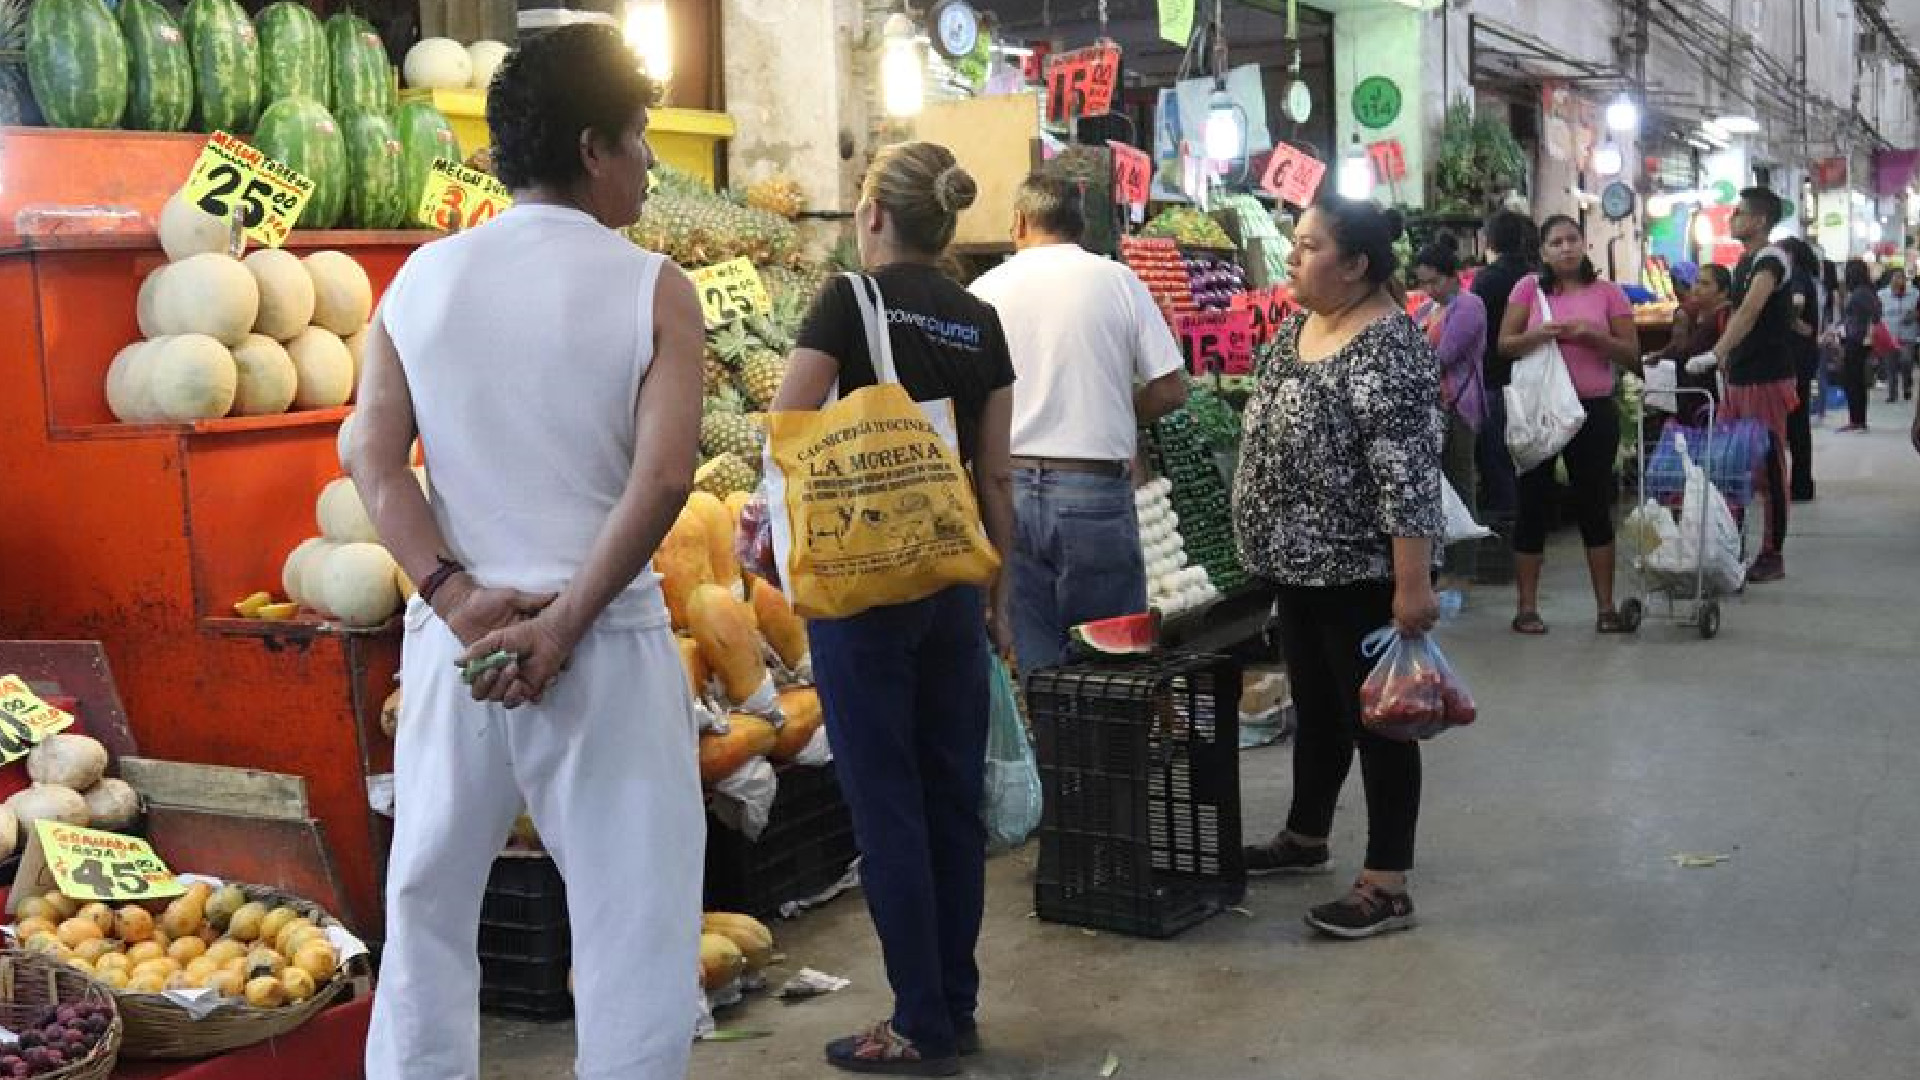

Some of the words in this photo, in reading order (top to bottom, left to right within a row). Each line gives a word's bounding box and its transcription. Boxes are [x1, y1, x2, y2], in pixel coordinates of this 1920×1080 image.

[1362, 102, 1392, 118] 114
[1369, 85, 1382, 101] J
[197, 163, 265, 228] 25
[705, 284, 755, 320] 25
[810, 459, 845, 477] LA
[850, 442, 942, 471] MORENA
[71, 859, 149, 897] 45
